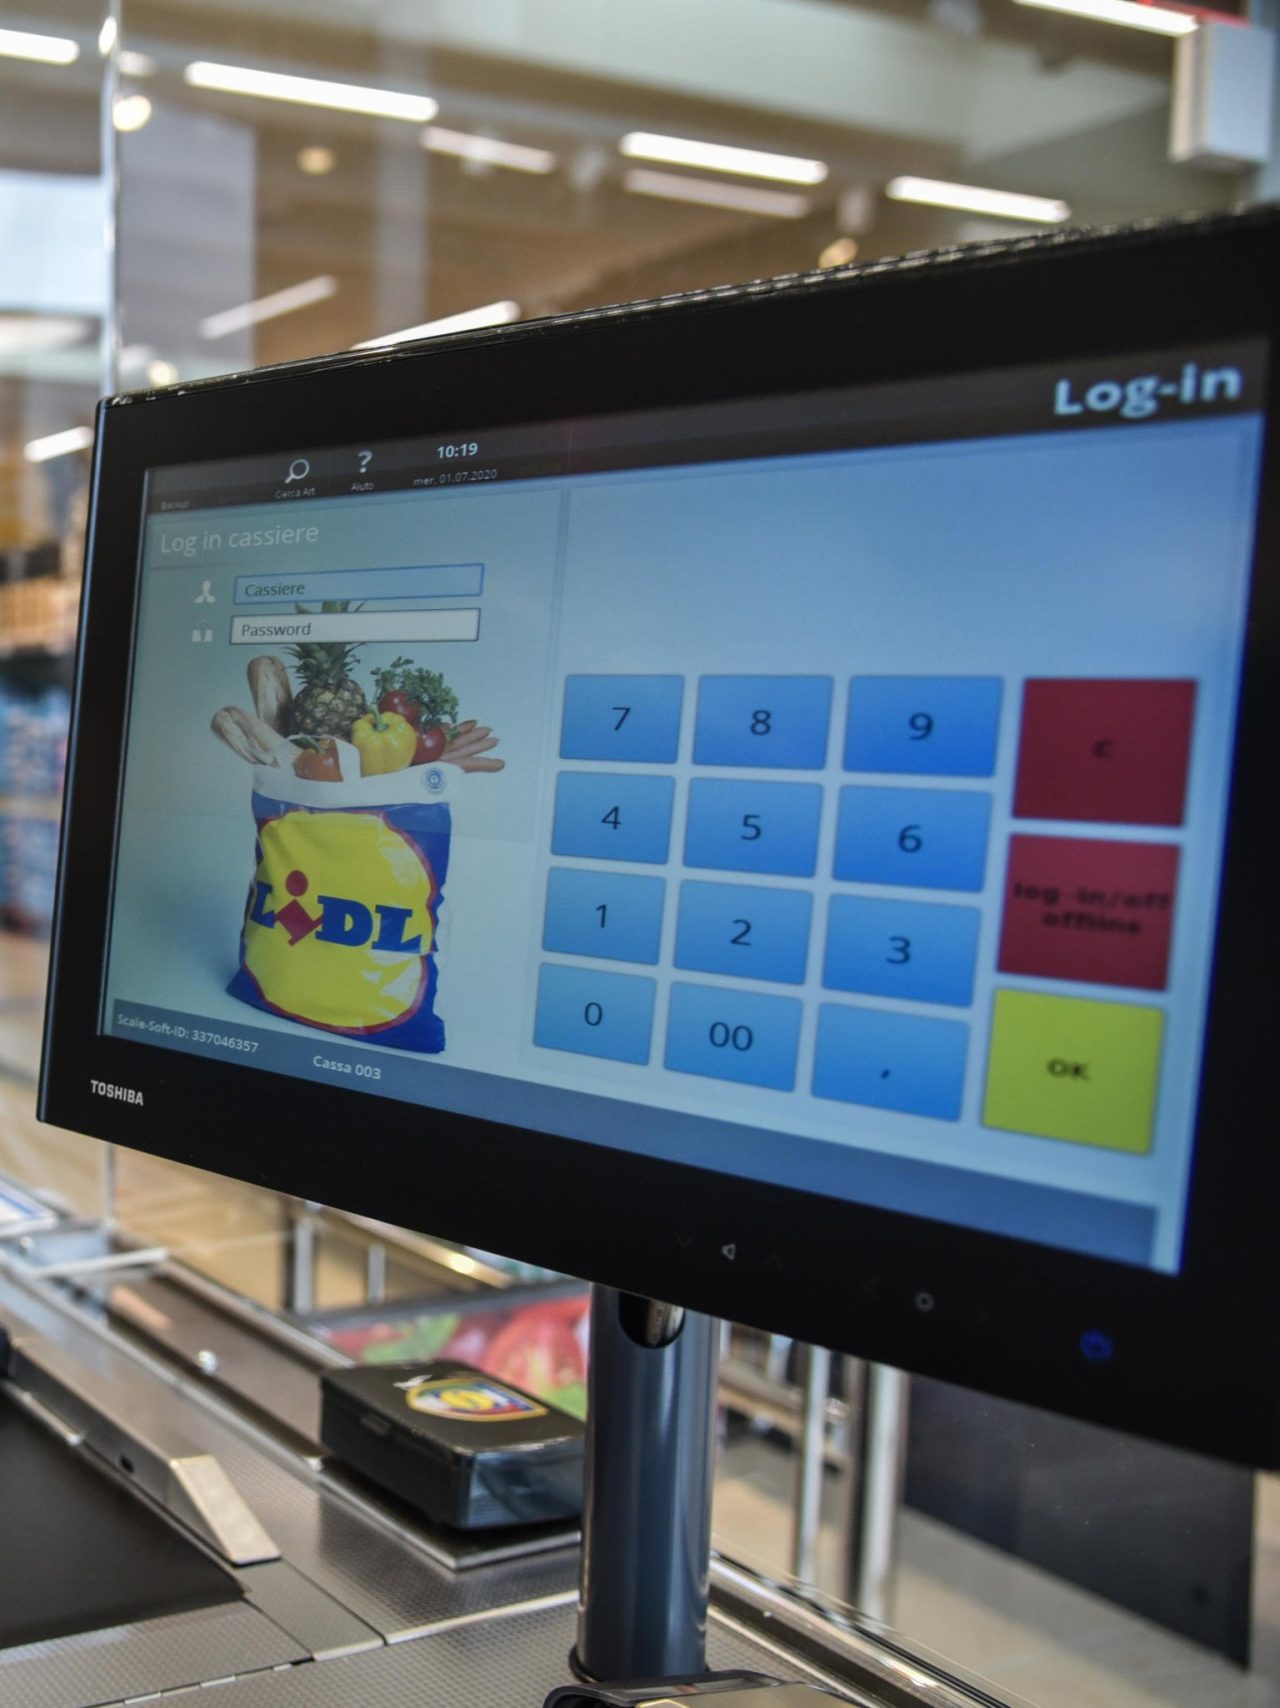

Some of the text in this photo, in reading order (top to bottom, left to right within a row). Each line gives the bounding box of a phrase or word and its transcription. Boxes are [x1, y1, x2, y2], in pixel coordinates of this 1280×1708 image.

[1053, 361, 1243, 418] Log-in
[437, 442, 478, 459] 10:19
[439, 468, 498, 484] 01.07.2020
[161, 525, 319, 557] Log in cassiere
[244, 582, 305, 597] Cassiere
[241, 622, 312, 637] Password
[611, 706, 631, 731] 7
[750, 709, 772, 736] 8
[908, 712, 934, 741] 9
[601, 806, 622, 830] 4
[740, 814, 762, 840] 5
[898, 824, 923, 853] 6
[595, 904, 608, 928] 1
[730, 919, 752, 946] 2
[885, 936, 912, 965] 3
[584, 1002, 604, 1026] 0
[117, 1013, 259, 1053] Scale-Soft-ID: 337046357
[708, 1021, 754, 1051] 00
[313, 1055, 381, 1080] Cassa 003
[1046, 1057, 1092, 1083] OK
[90, 1079, 144, 1106] TOSHIBA
